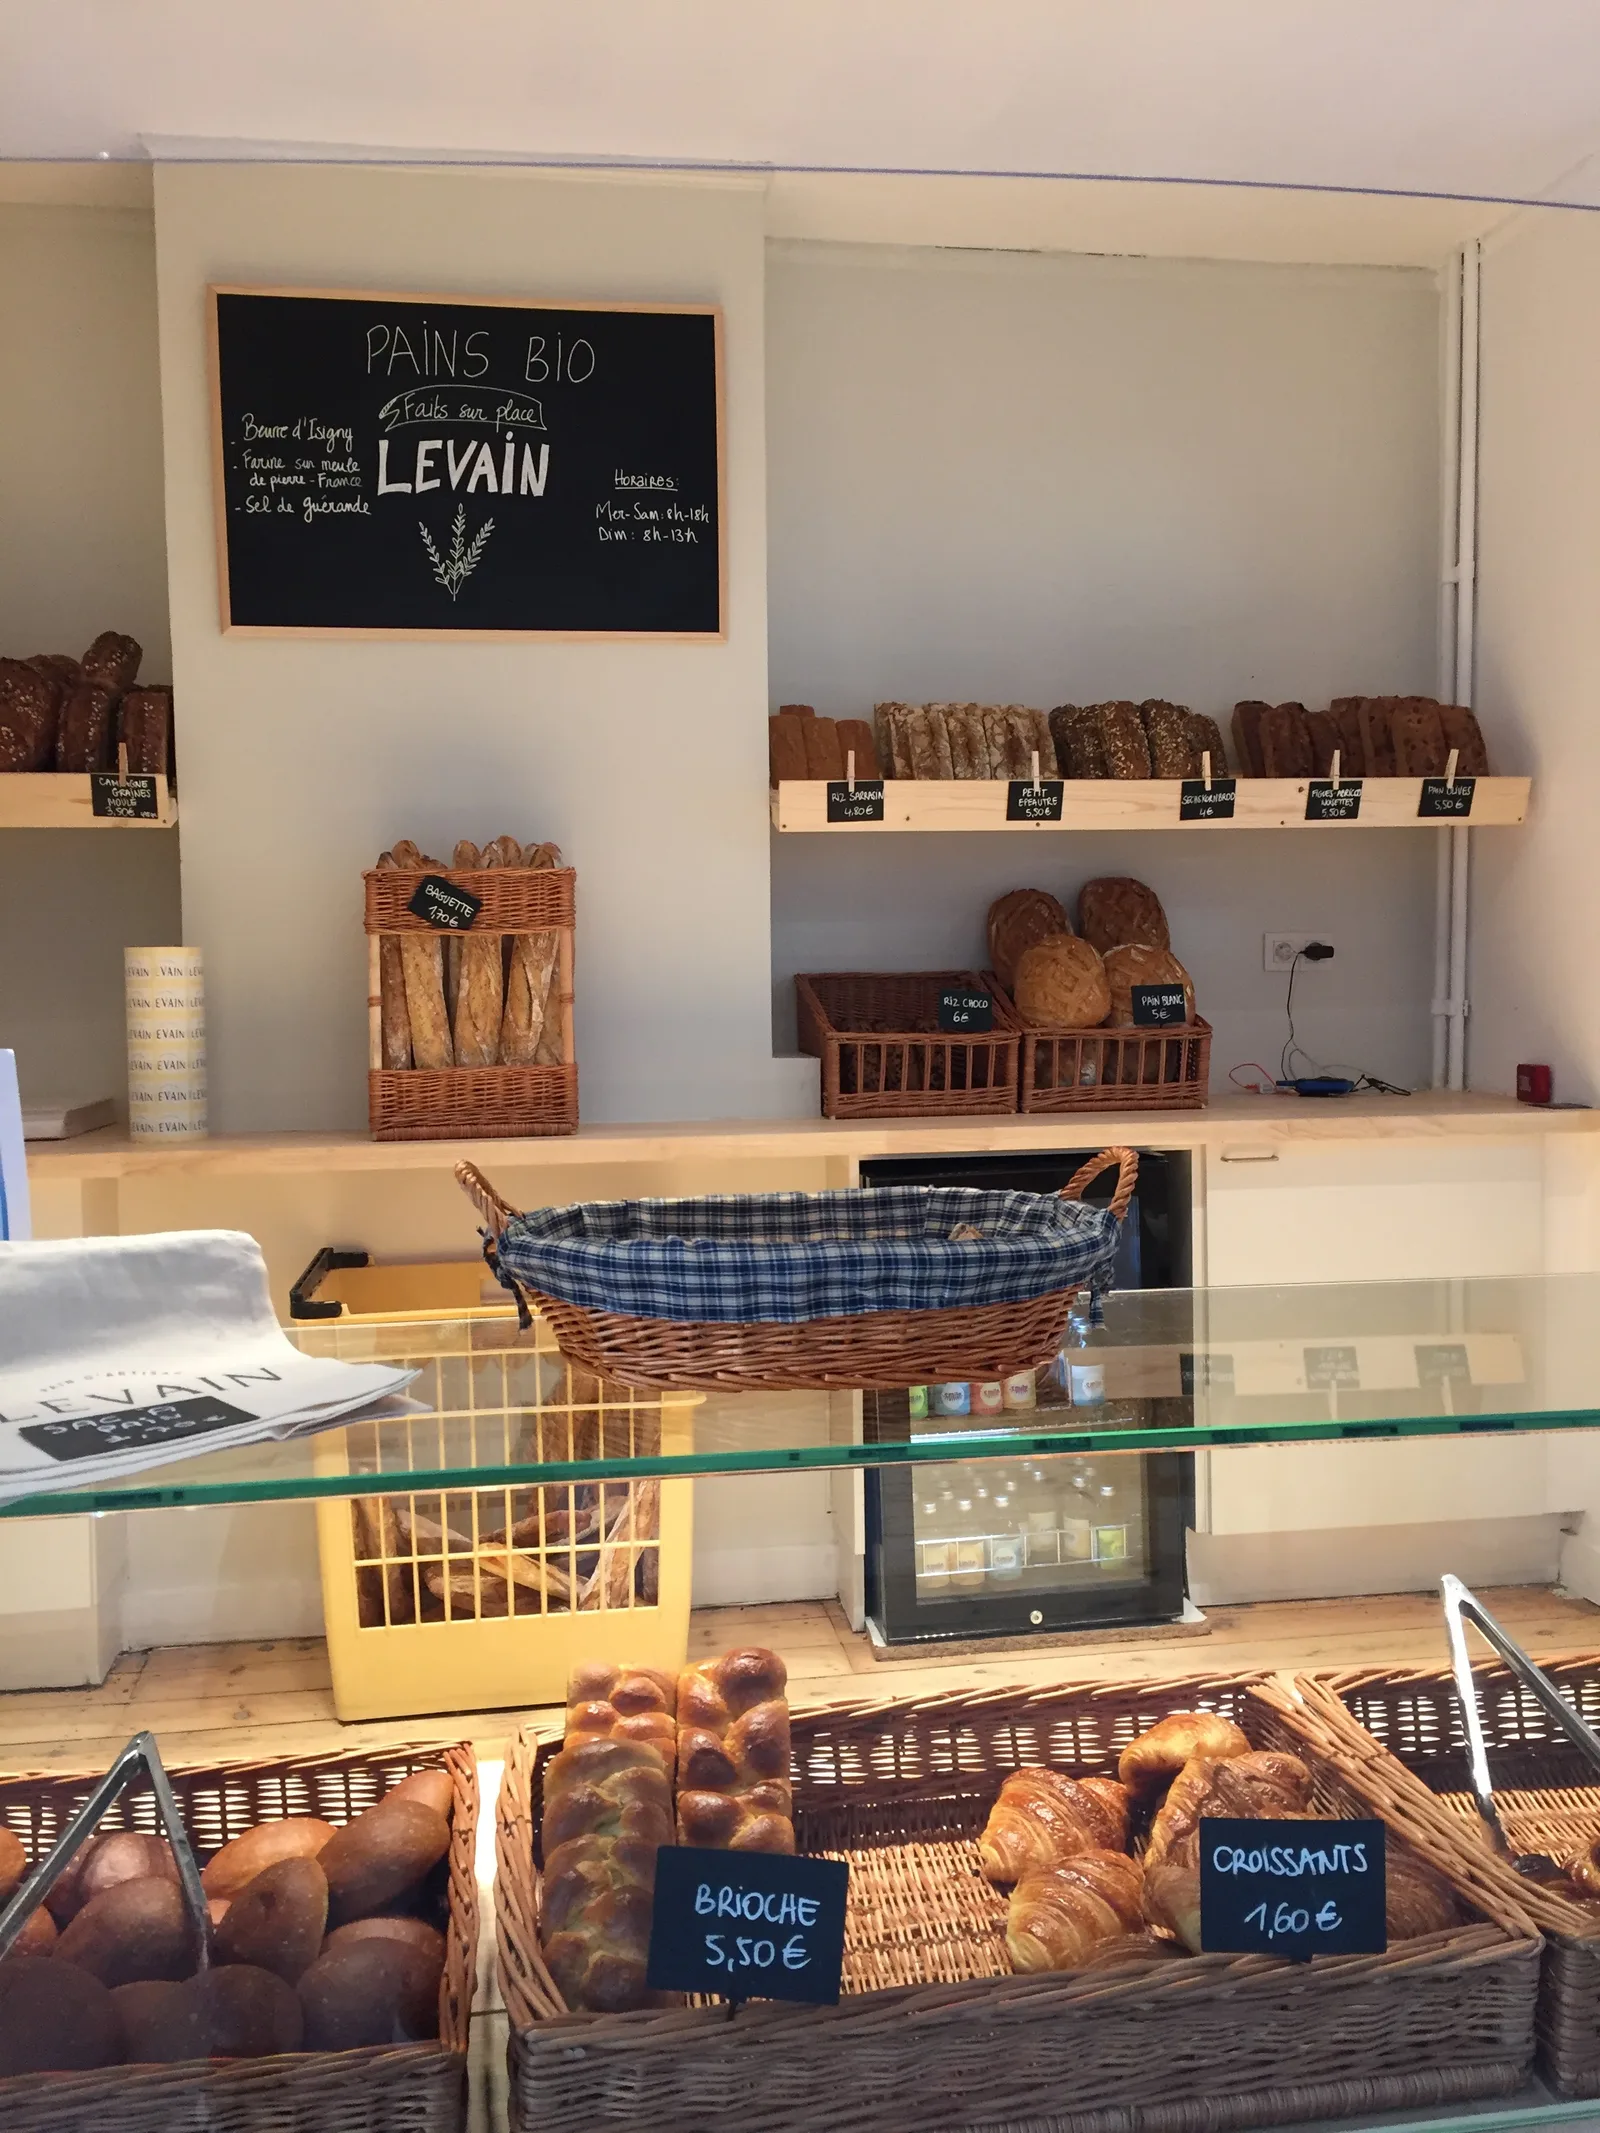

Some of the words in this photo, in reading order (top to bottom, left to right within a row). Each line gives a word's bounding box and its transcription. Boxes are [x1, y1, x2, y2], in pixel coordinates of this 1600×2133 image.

[404, 392, 449, 420] Faits
[459, 402, 488, 421] sur
[496, 398, 538, 433] place
[292, 416, 354, 453] d'Isigny
[242, 448, 286, 469] Farine
[294, 458, 316, 469] sur
[321, 457, 361, 472] meule
[249, 472, 267, 487] de
[270, 473, 306, 492] pierre
[317, 472, 363, 488] France
[246, 494, 272, 513] Sel
[277, 497, 295, 513] de
[643, 525, 699, 543] 8h-13h
[98, 777, 148, 788] CAMGNE
[111, 787, 151, 798] GRAINES
[425, 884, 475, 918] BAGUETTE
[962, 998, 988, 1008] CHOCO
[1161, 994, 1184, 1006] BLANC
[952, 1010, 969, 1023] 6€
[1151, 1008, 1171, 1020] 5€
[1212, 1842, 1369, 1878] CROISSANTS
[694, 1882, 821, 1927] BRIOCHE
